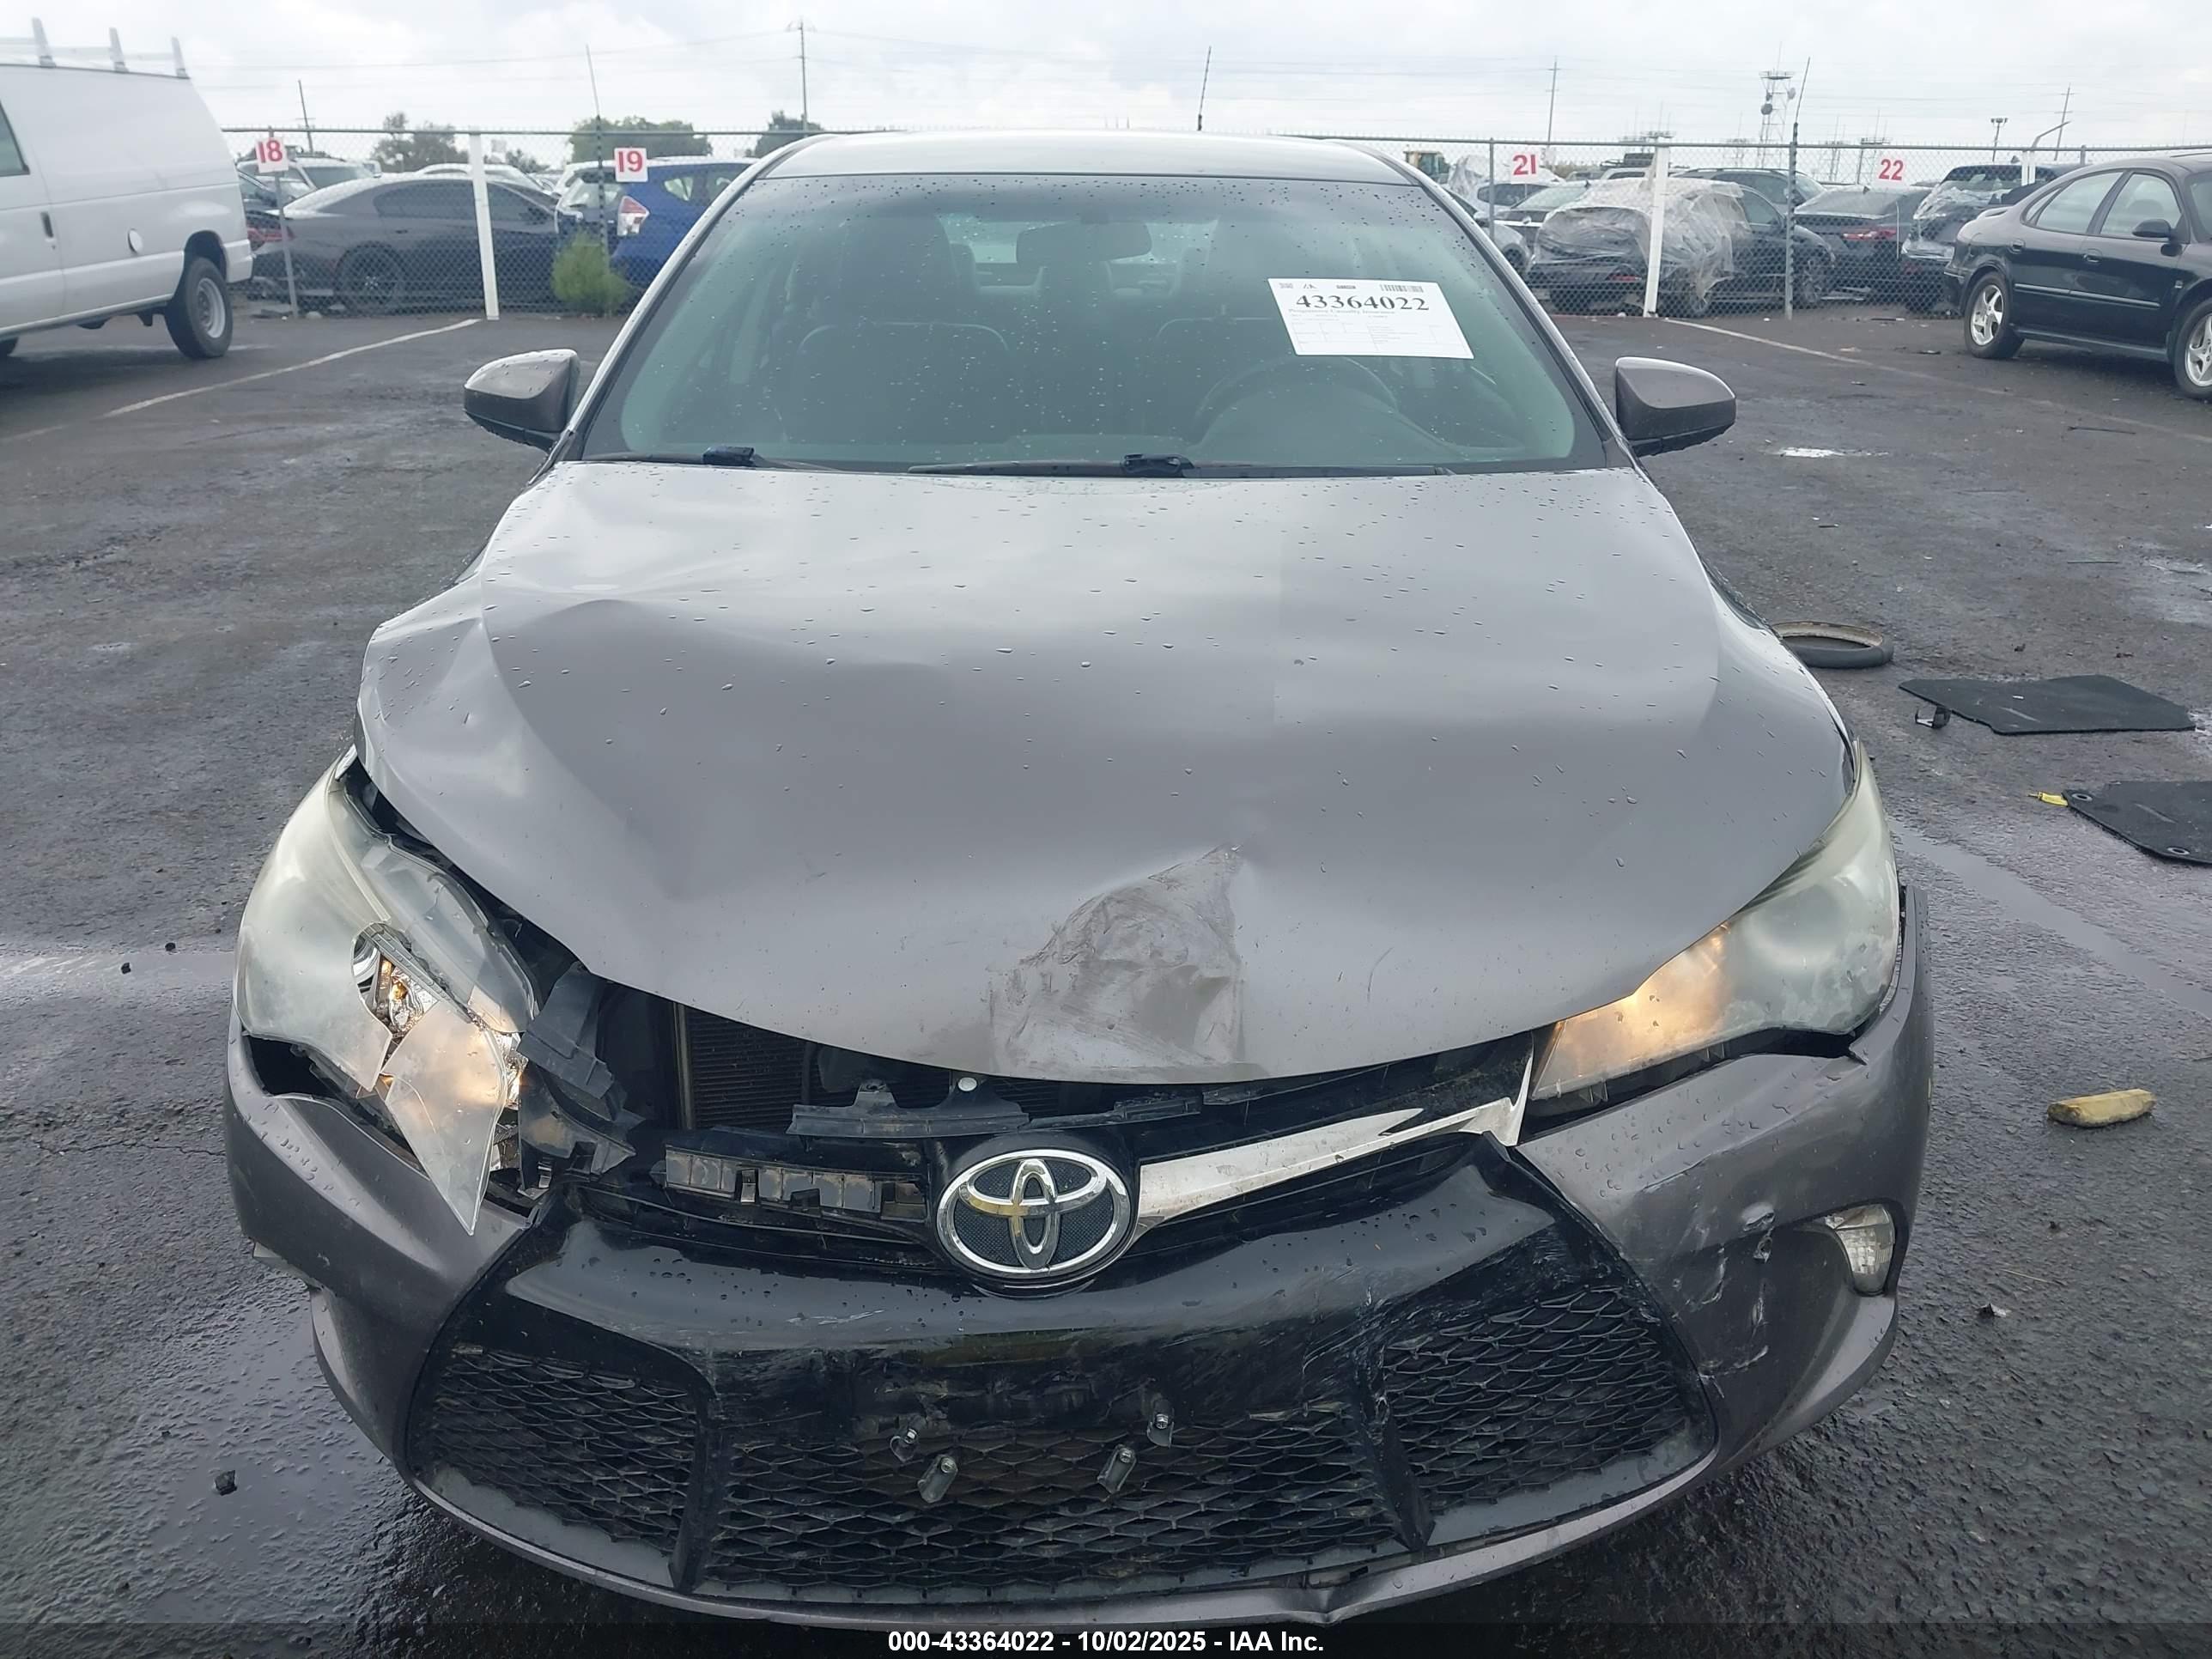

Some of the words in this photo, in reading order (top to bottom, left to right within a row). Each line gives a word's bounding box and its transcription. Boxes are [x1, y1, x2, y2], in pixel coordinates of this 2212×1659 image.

[258, 140, 283, 163] 18
[618, 150, 642, 173] 19
[1512, 154, 1536, 175] 21
[1878, 158, 1904, 180] 22
[1296, 295, 1430, 311] 43364022
